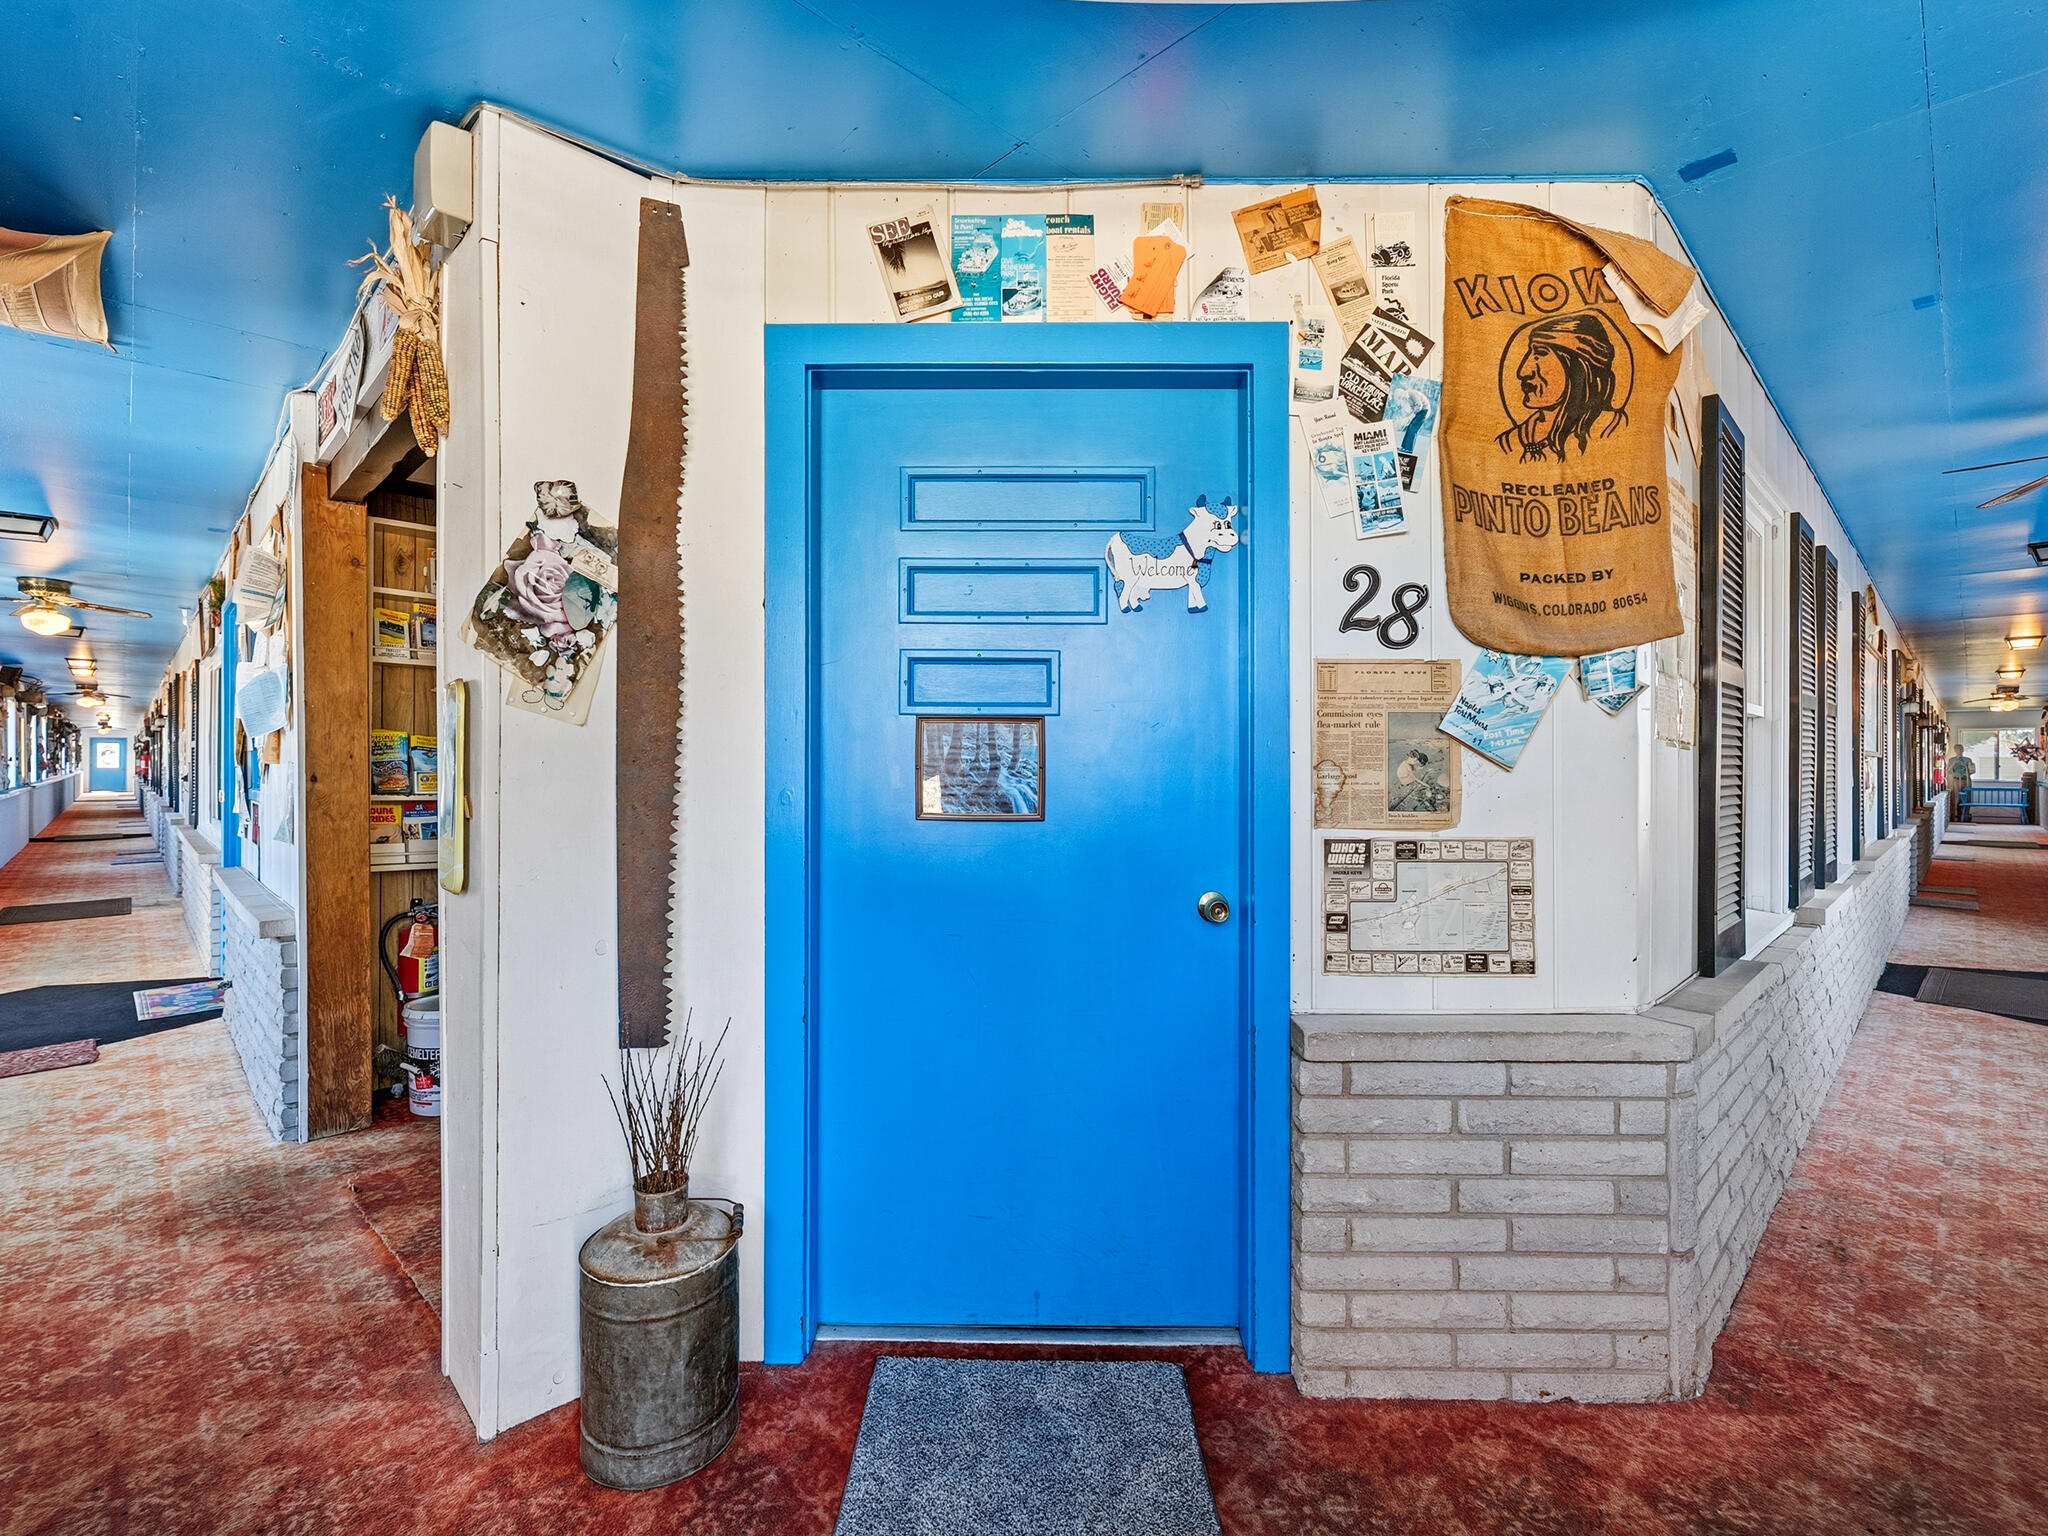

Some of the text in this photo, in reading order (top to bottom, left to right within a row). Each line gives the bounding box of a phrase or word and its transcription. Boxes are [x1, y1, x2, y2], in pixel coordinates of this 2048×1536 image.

[870, 217, 911, 243] SEE
[1046, 225, 1092, 235] boat rentals
[1090, 273, 1119, 310] FLIGHT
[1454, 266, 1622, 320] KIOW
[1361, 328, 1412, 376] MAP
[1345, 370, 1361, 387] OLD
[1353, 428, 1387, 442] MIAMI
[1502, 478, 1615, 496] RECLEANED
[1453, 483, 1549, 537] PINTO
[1559, 485, 1662, 536] BEANS
[1129, 555, 1194, 577] Welcome
[1520, 568, 1614, 584] PACKED BY
[1339, 563, 1430, 650] 28
[1543, 600, 1607, 616] COLORADO
[1613, 591, 1648, 609] 80654
[1316, 709, 1384, 720] Commission eyes
[1316, 720, 1381, 729] flea-market rule
[1483, 727, 1525, 740] Post Time
[371, 807, 394, 815] DUNE
[371, 815, 397, 823] RIDES
[1330, 843, 1366, 854] WHO'S
[1327, 853, 1366, 864] WHERE
